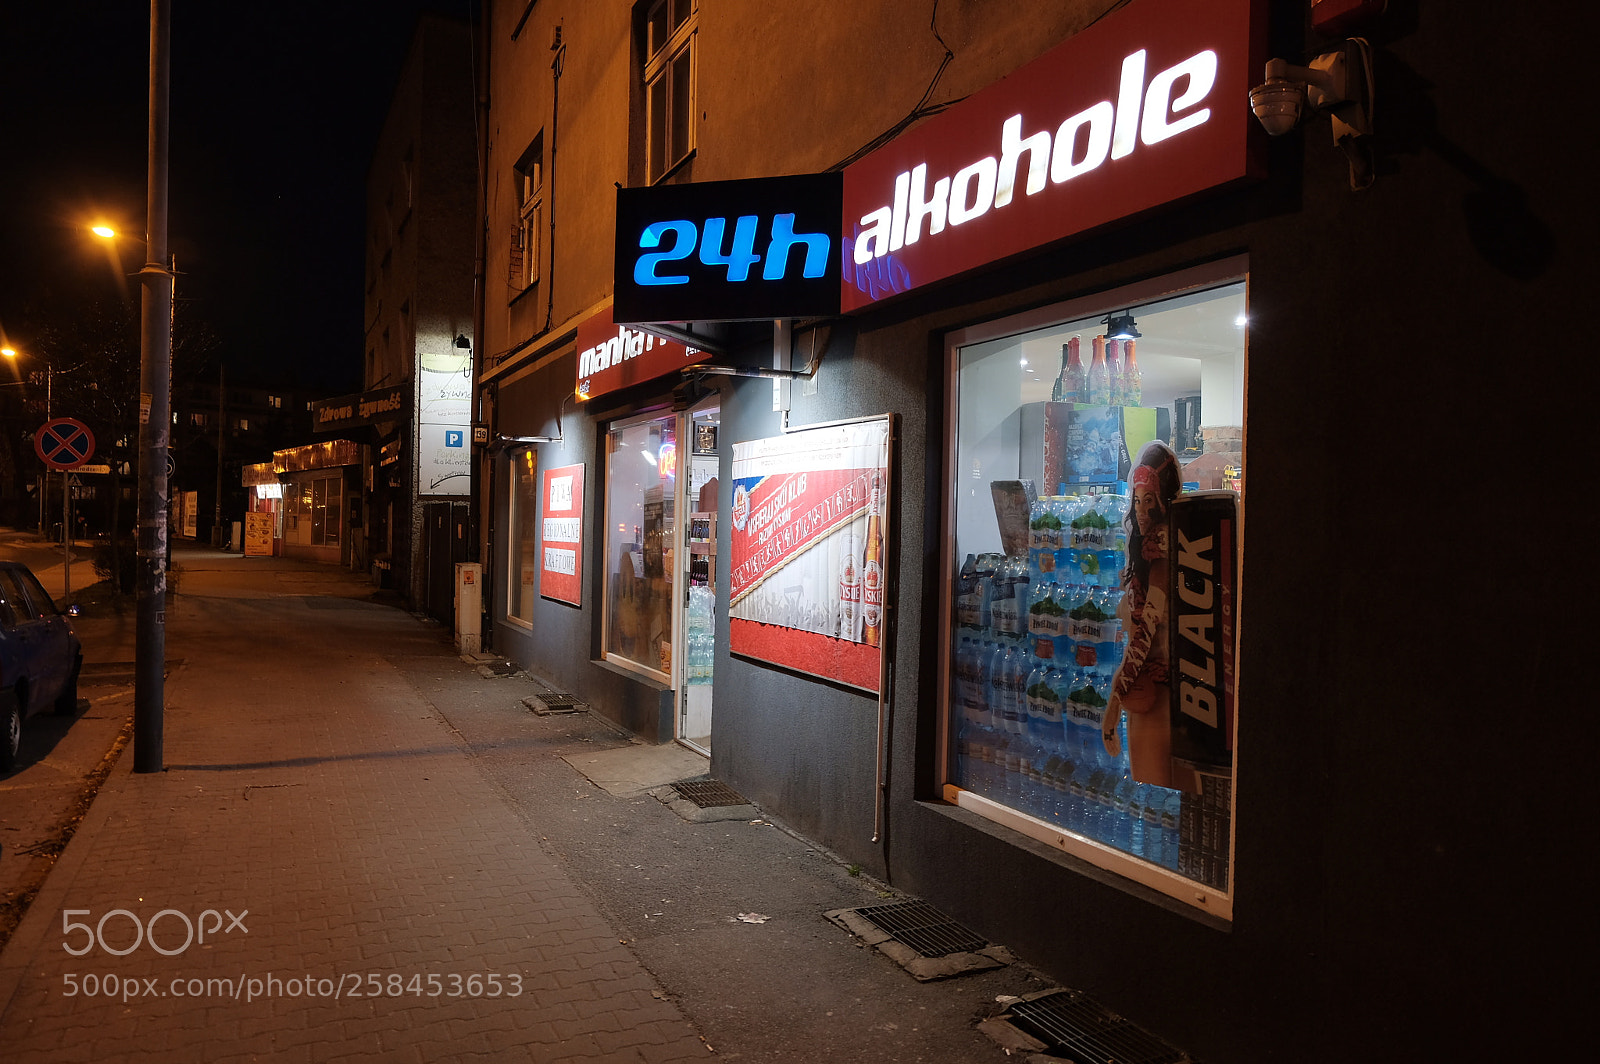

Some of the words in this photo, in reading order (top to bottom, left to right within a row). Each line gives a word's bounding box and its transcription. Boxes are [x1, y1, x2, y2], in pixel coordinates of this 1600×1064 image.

[853, 48, 1218, 265] alkohole
[633, 212, 831, 286] 24h
[449, 433, 459, 445] P
[660, 448, 676, 475] OPE
[545, 552, 575, 571] KRAFTOWE
[1177, 527, 1219, 729] BLACK
[1221, 583, 1234, 696] ENERGY
